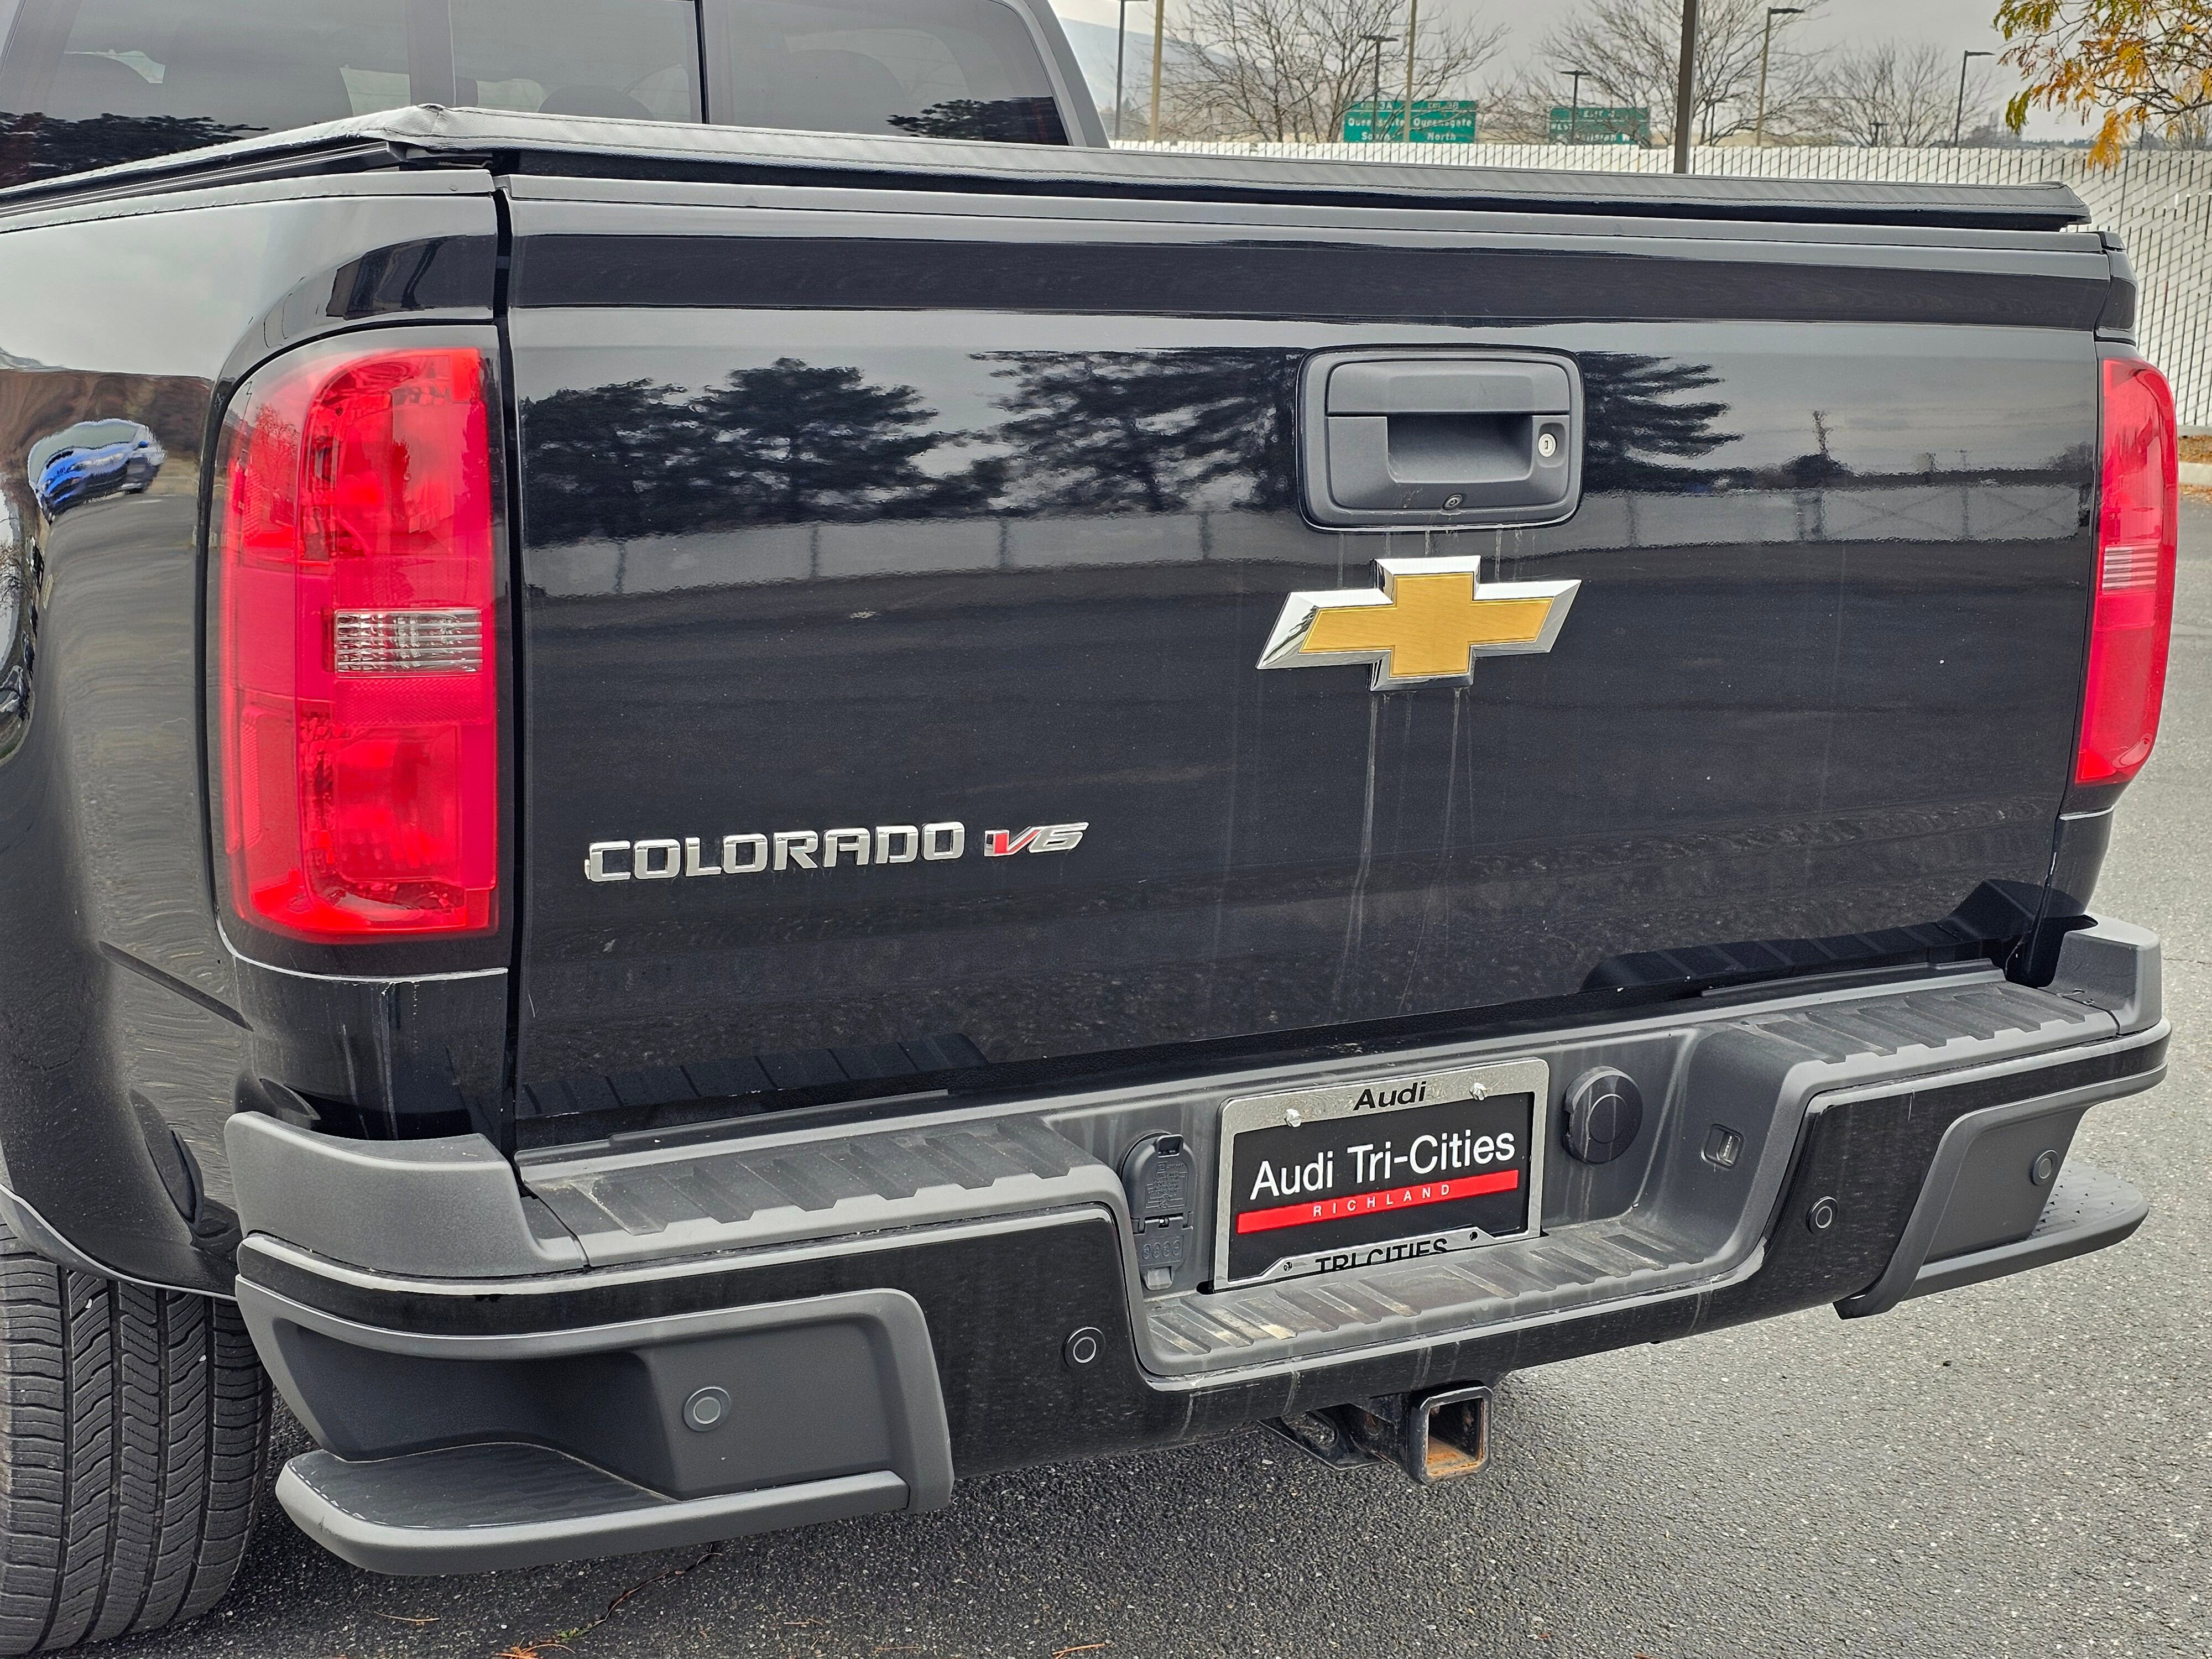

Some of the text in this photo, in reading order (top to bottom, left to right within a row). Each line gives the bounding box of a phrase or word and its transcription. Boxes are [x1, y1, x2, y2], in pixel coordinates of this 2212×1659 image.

[1413, 117, 1472, 129] Queensgate
[1427, 132, 1457, 141] North
[585, 821, 1089, 883] COLORADO V6
[1353, 1081, 1427, 1112] Audi
[1250, 1129, 1515, 1201] Audi Tri-Cities
[1312, 1183, 1451, 1217] RICHLAND
